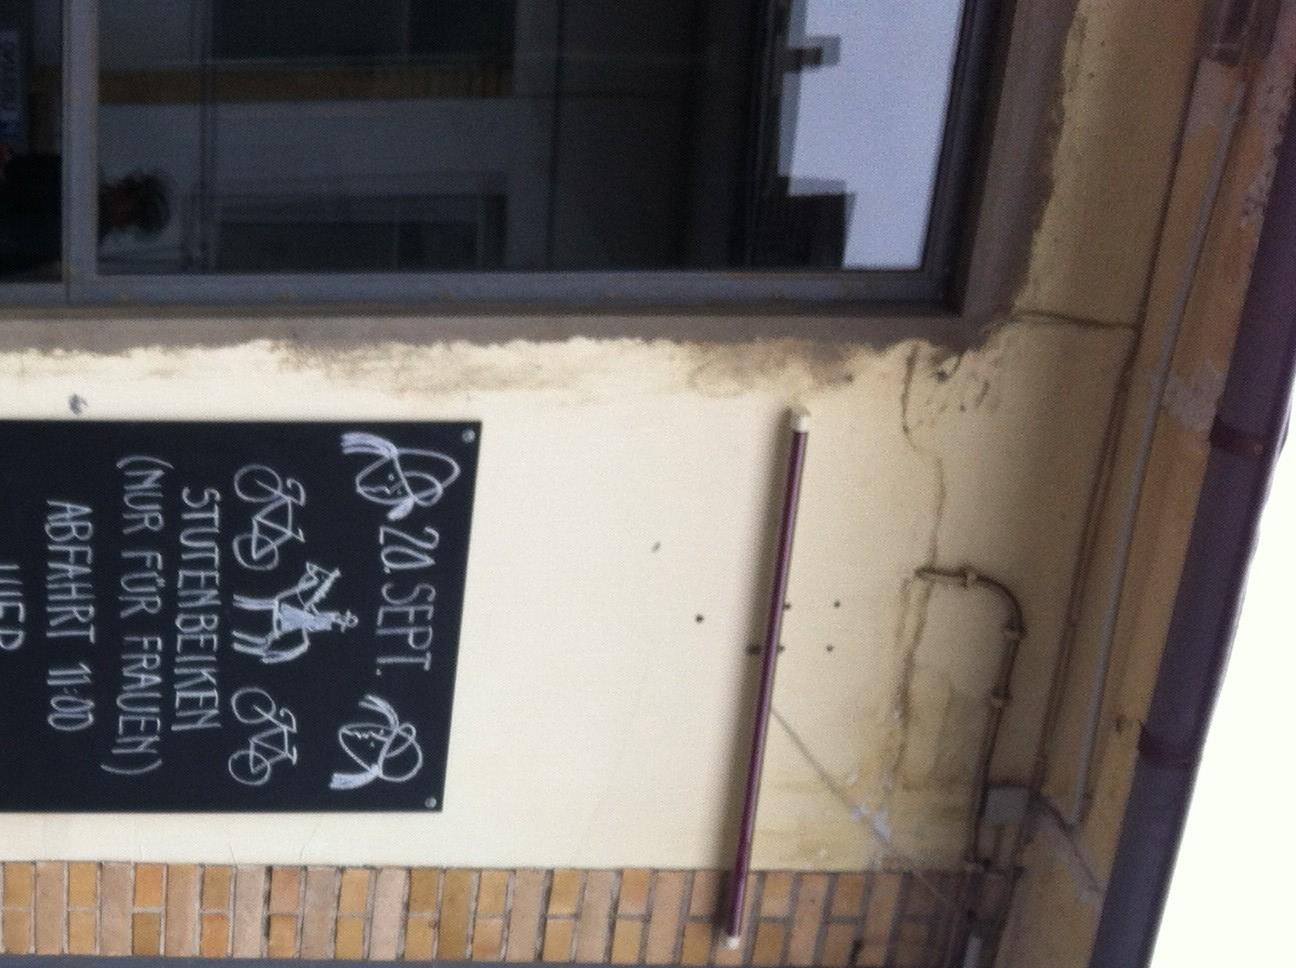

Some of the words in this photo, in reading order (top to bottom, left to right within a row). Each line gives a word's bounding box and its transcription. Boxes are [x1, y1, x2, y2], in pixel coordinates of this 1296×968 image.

[115, 454, 175, 535] (NUR
[44, 498, 96, 645] ABFAHRT
[118, 549, 165, 619] FÜR
[378, 525, 440, 574] 20.
[170, 486, 222, 732] STUTENBEIKEN
[375, 583, 437, 677] SEPT.
[46, 662, 95, 732] 11:00
[100, 634, 164, 776] FRAUEN)
